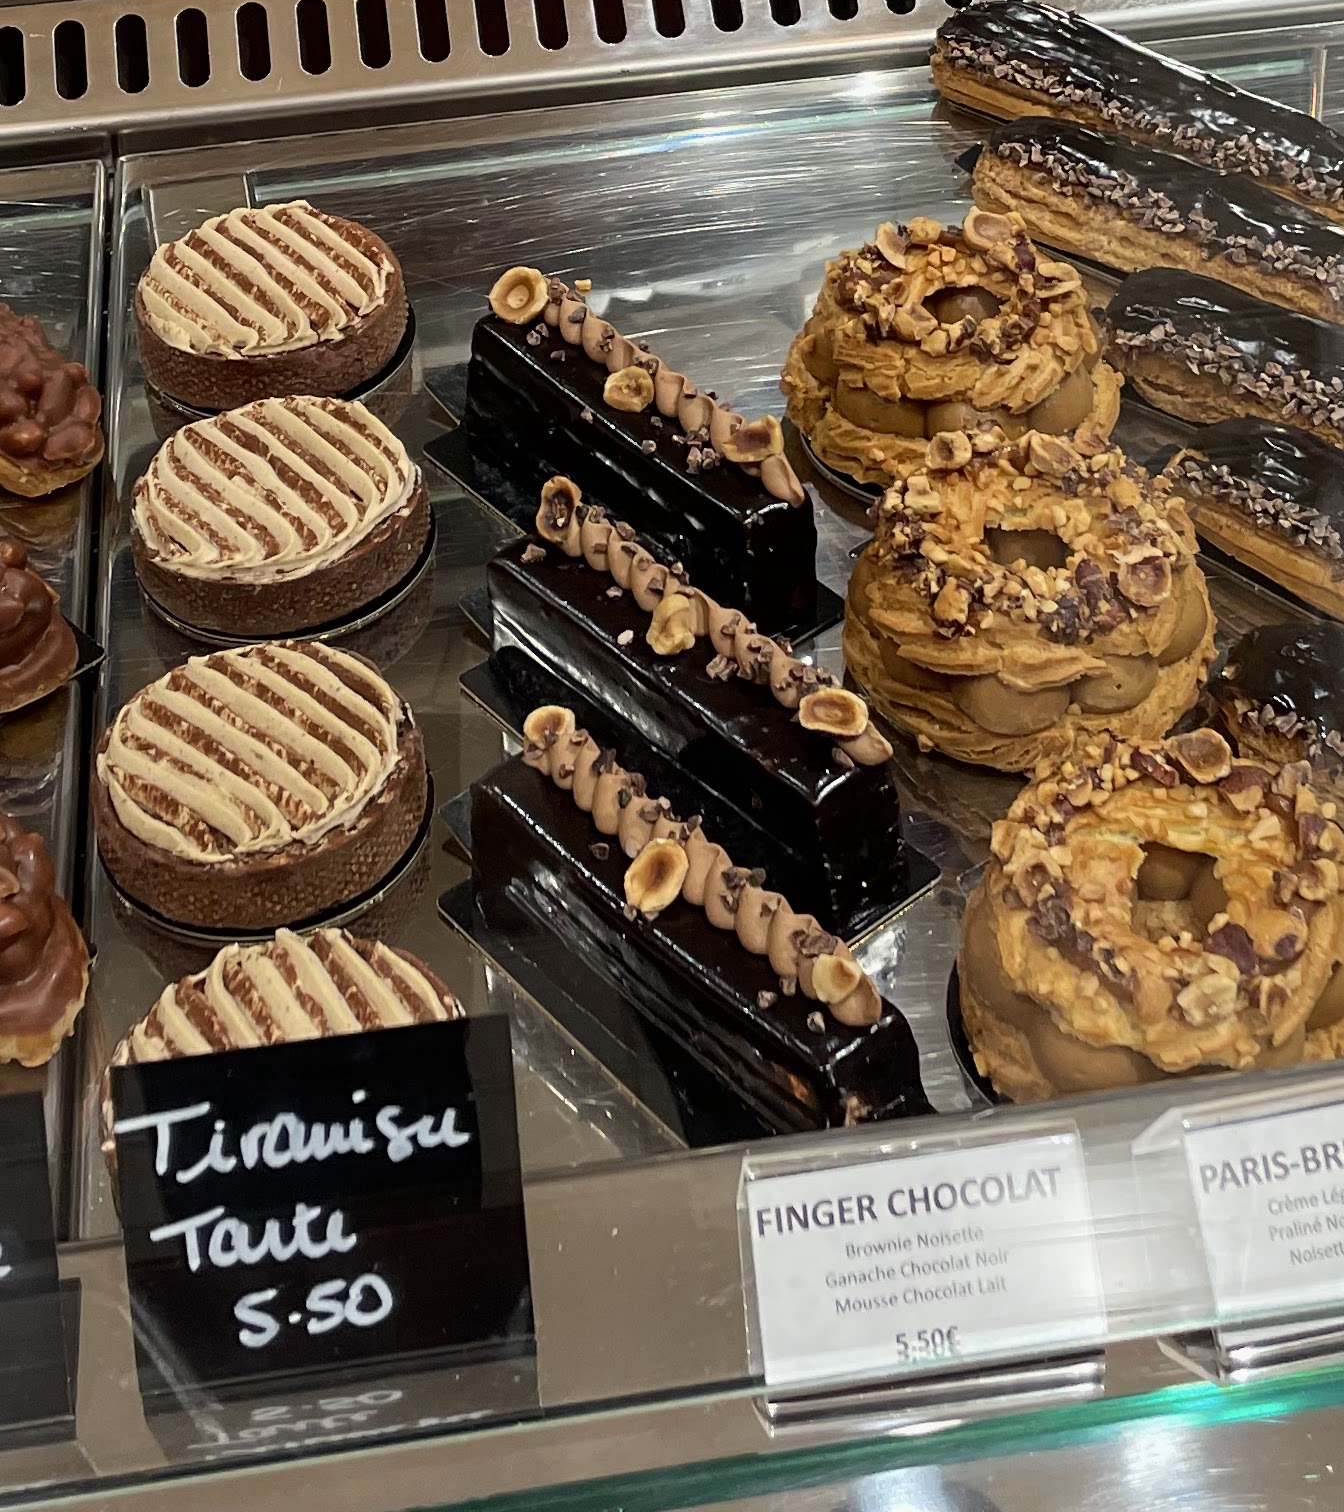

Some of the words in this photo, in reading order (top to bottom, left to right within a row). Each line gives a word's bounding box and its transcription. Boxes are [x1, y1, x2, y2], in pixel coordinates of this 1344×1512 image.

[114, 1090, 470, 1184] Tiramisu
[757, 1194, 878, 1237] FINGER
[887, 1167, 1061, 1218] CHOCOLAT
[1267, 1193, 1319, 1216] Crème
[845, 1236, 912, 1259] Brownie
[917, 1225, 984, 1248] Noisette
[1268, 1216, 1322, 1242] Praliné
[825, 1265, 896, 1289] Ganache
[900, 1253, 970, 1278] Chocolat
[975, 1248, 1009, 1267] Noir
[233, 1273, 394, 1348] 5.50
[835, 1293, 898, 1316] Mousse
[903, 1278, 974, 1304] Chocolat
